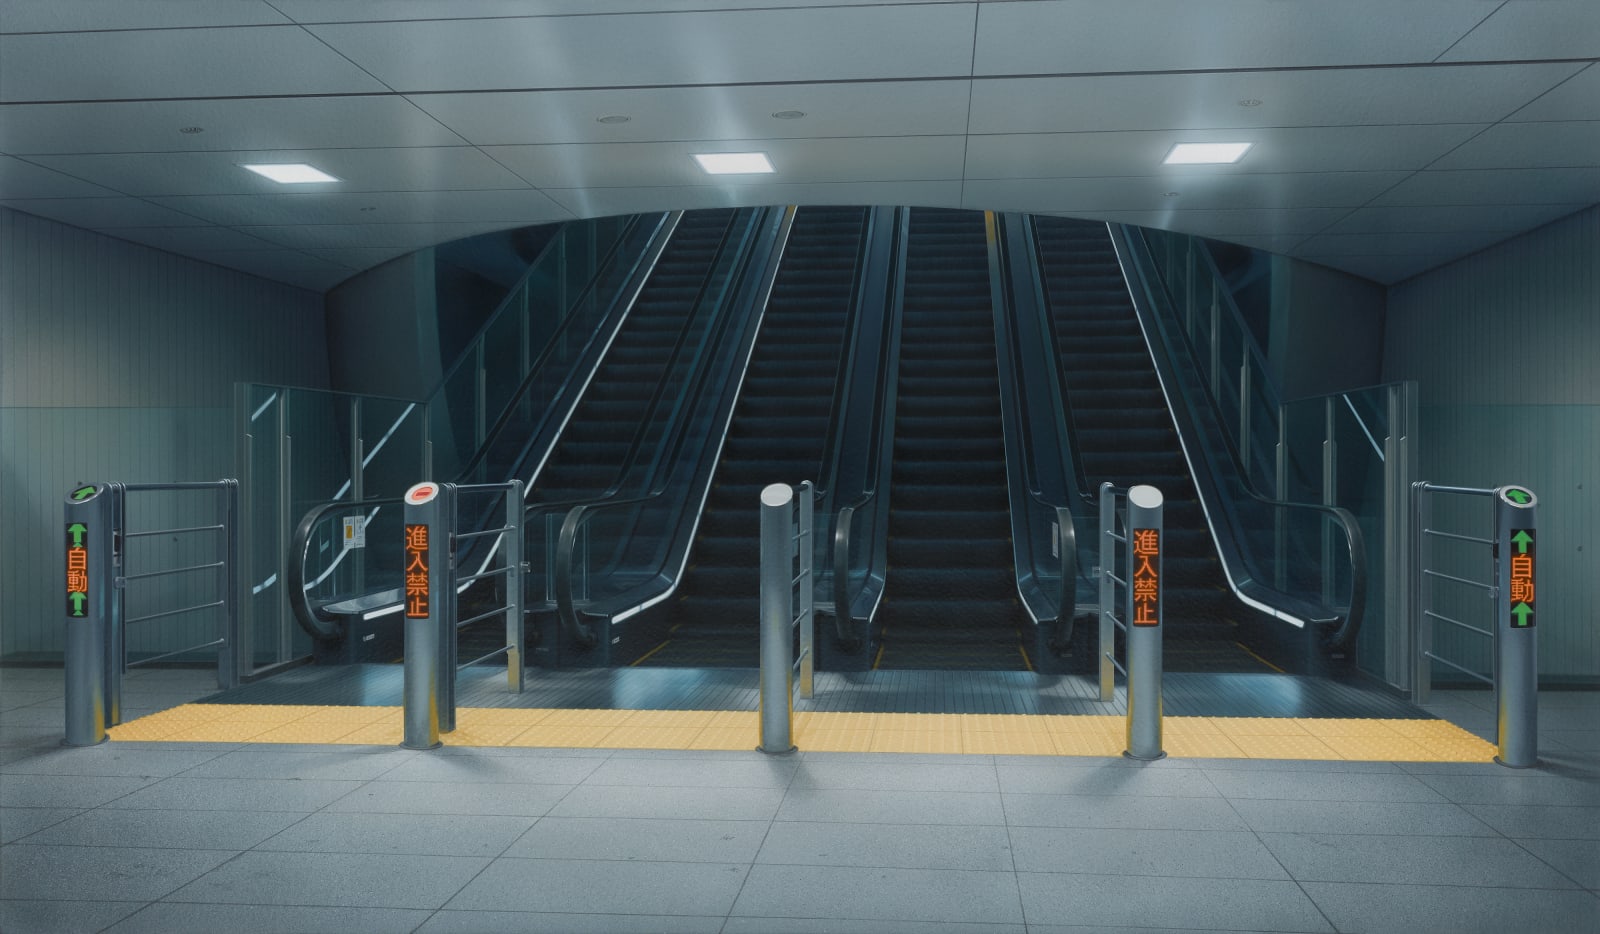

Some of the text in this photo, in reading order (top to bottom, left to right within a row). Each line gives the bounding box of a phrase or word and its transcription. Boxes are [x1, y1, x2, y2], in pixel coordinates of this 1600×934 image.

[67, 547, 88, 592] 自動
[406, 525, 429, 617] 進入禁止
[1134, 529, 1159, 624] 進入禁止
[1511, 553, 1535, 603] 自動
